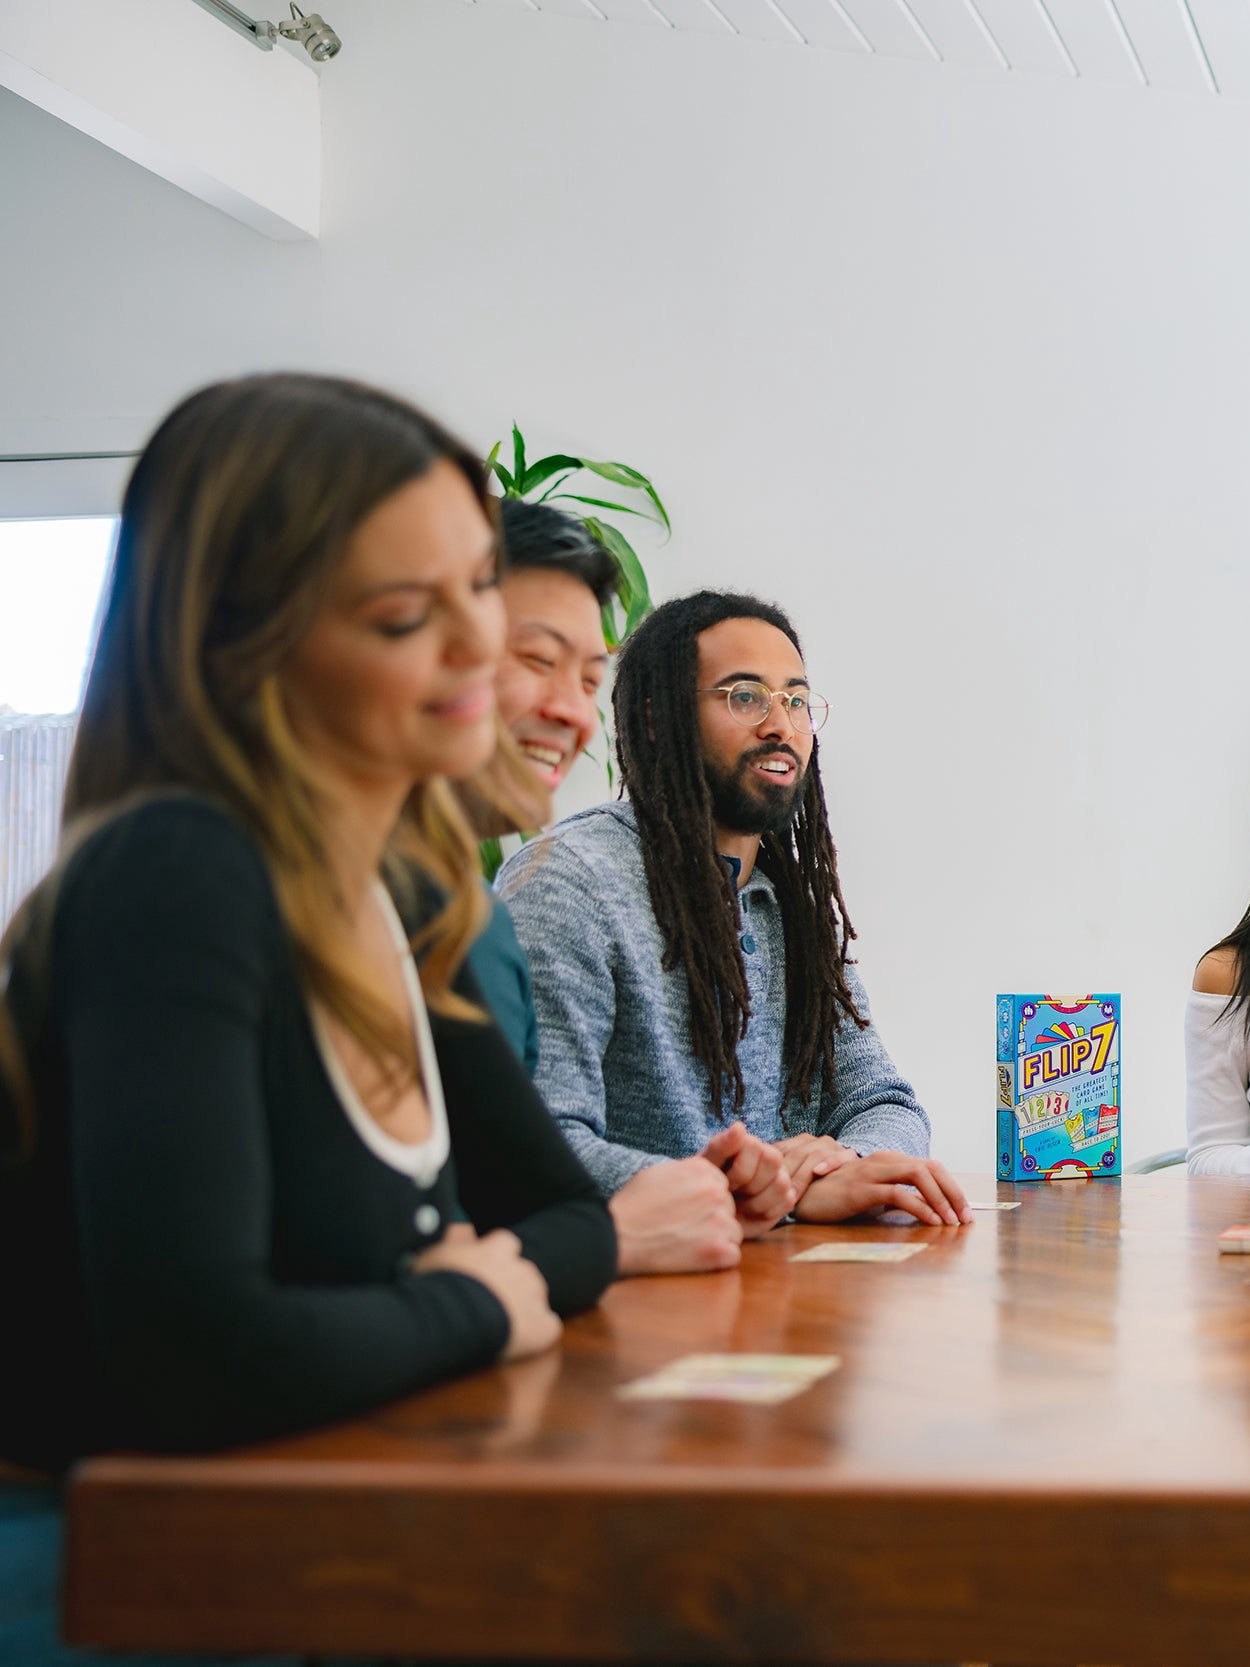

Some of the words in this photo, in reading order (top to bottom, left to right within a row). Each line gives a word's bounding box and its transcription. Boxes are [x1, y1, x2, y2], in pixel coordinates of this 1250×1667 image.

[1024, 1039, 1092, 1089] FLIP
[1090, 1019, 1117, 1075] 7
[1076, 1089, 1090, 1099] CARD
[1084, 1096, 1093, 1104] ALL
[1020, 1106, 1031, 1124] 1
[1036, 1099, 1046, 1118] 2
[1053, 1097, 1062, 1115] 3
